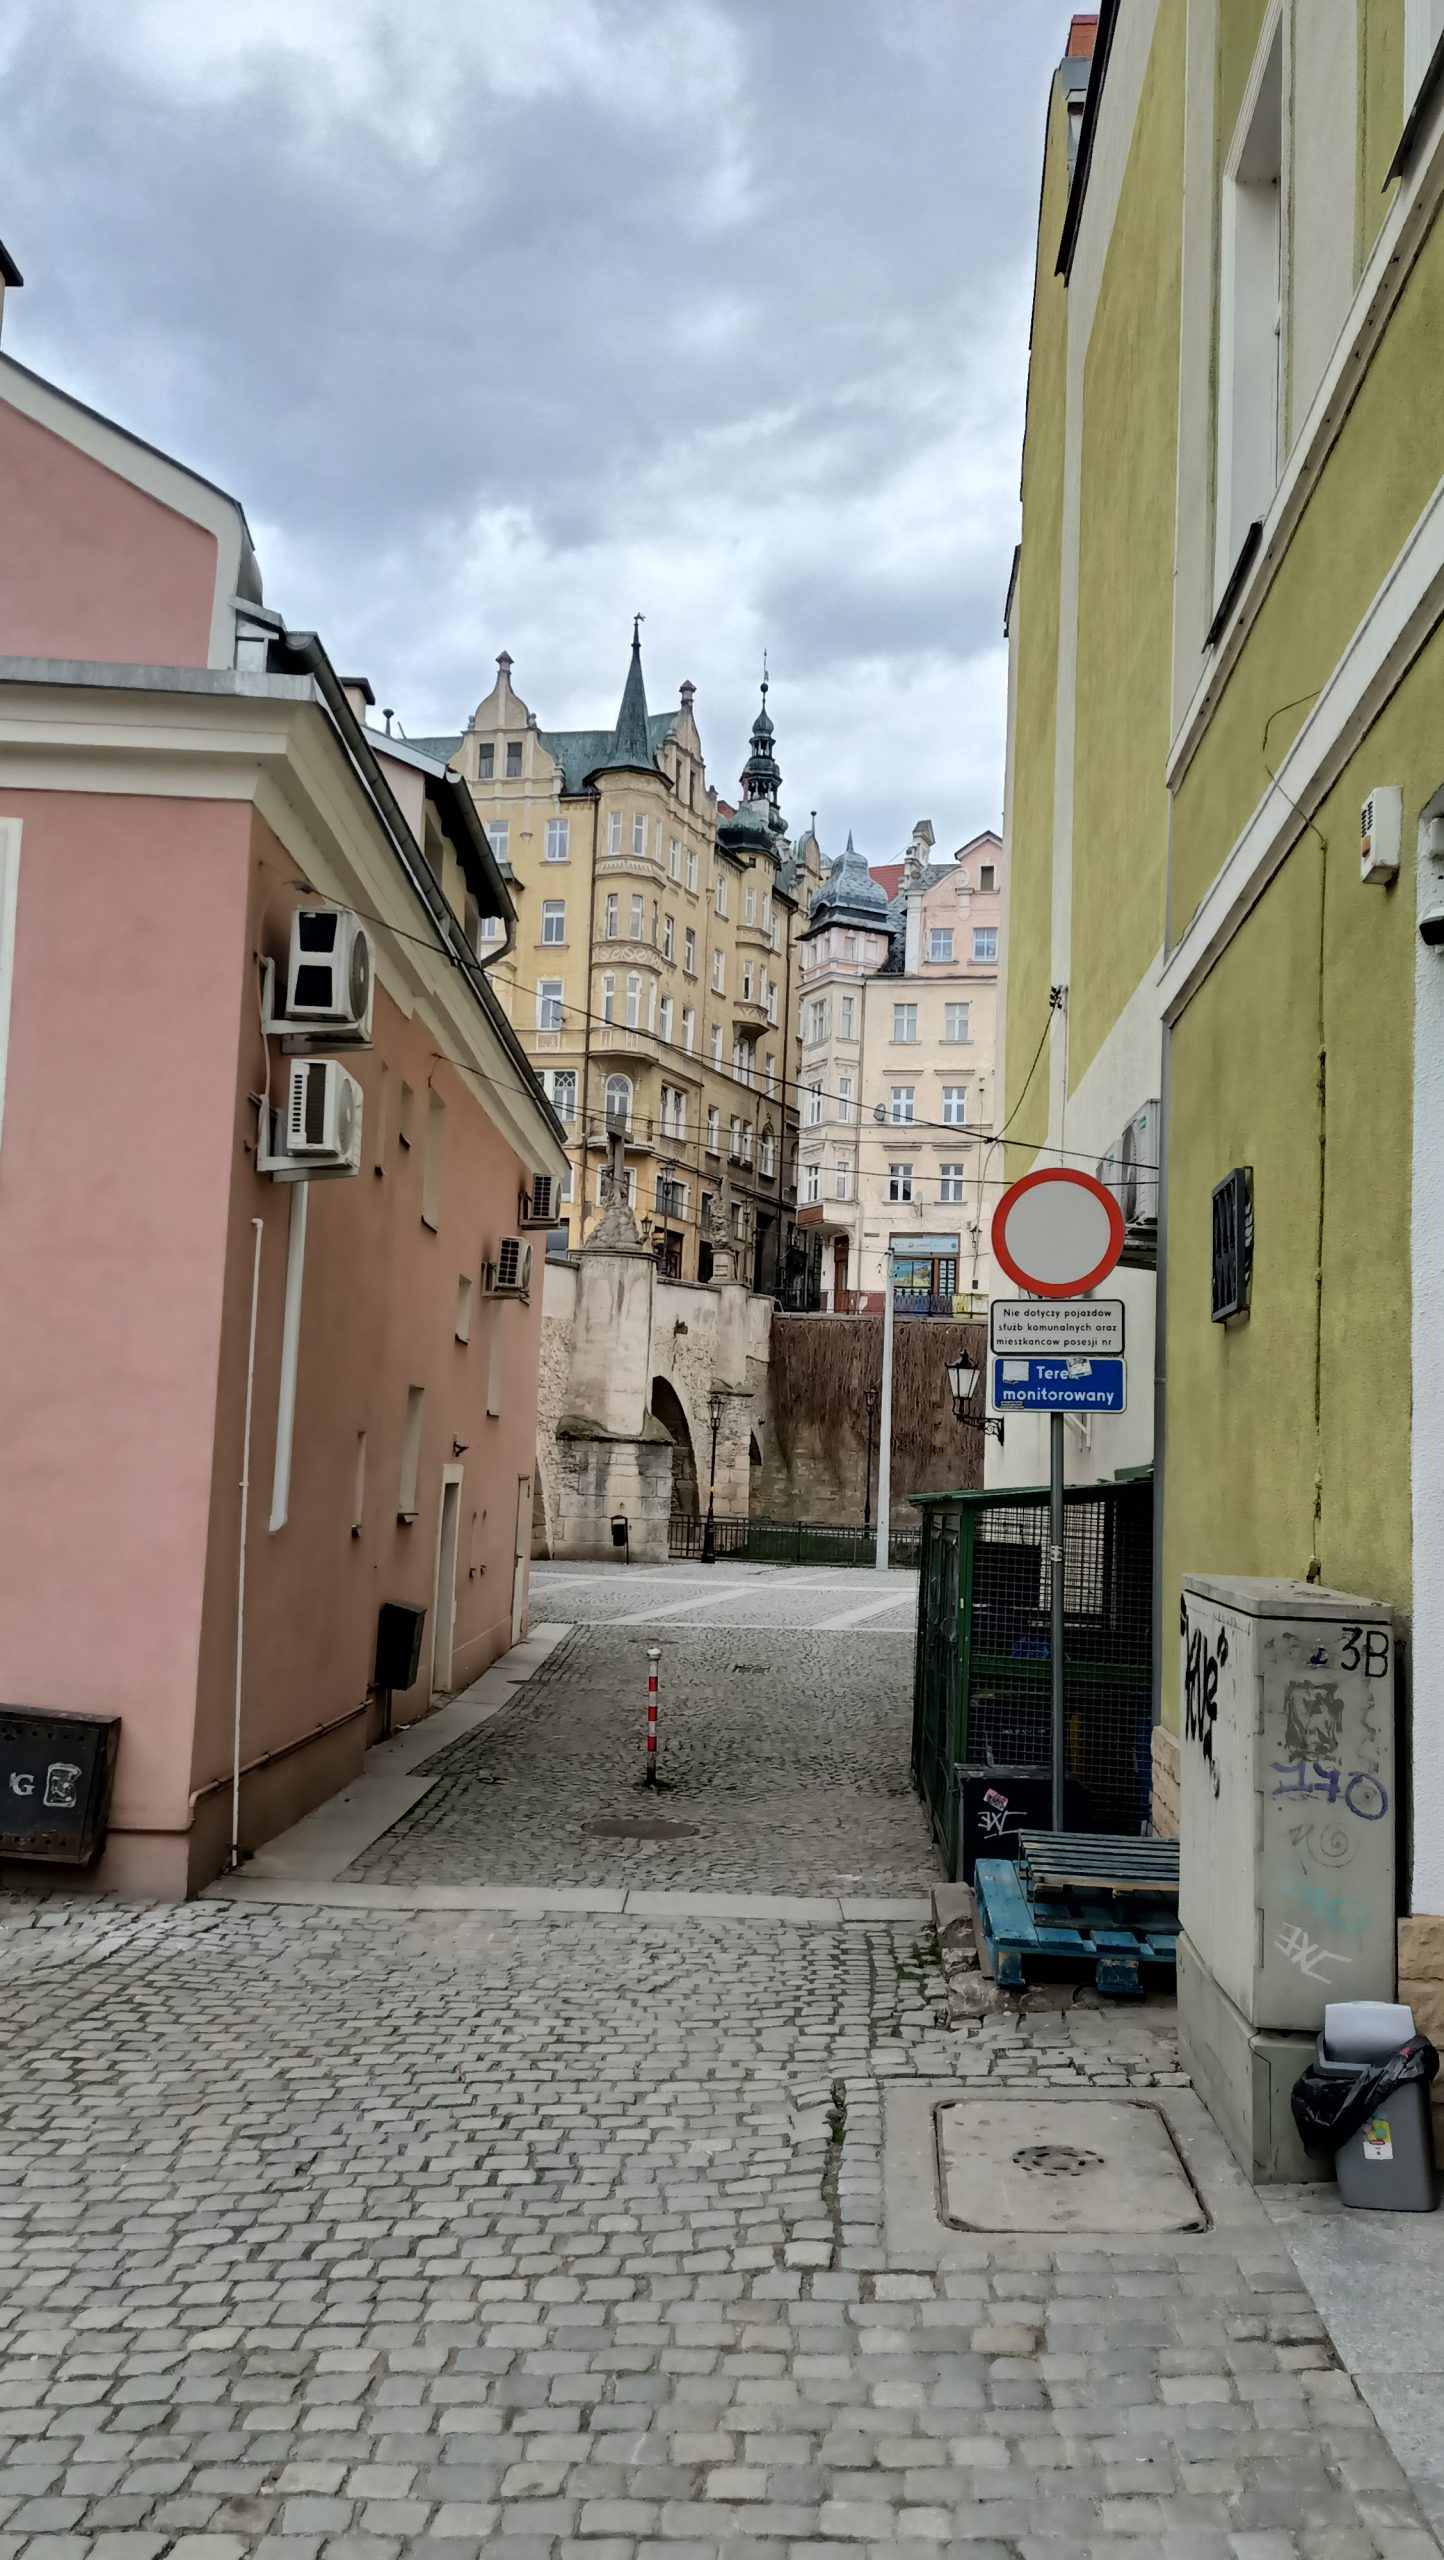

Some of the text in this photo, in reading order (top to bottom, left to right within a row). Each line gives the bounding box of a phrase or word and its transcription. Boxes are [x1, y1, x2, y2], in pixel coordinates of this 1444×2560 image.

[1003, 1308, 1020, 1317] Nie
[1023, 1308, 1060, 1319] dotyczy
[1027, 1323, 1092, 1333] komunalnych
[1063, 1338, 1098, 1348] posesji
[1036, 1365, 1079, 1380] Tere
[1003, 1387, 1115, 1405] monitorowany
[1340, 1626, 1389, 1678] 3B
